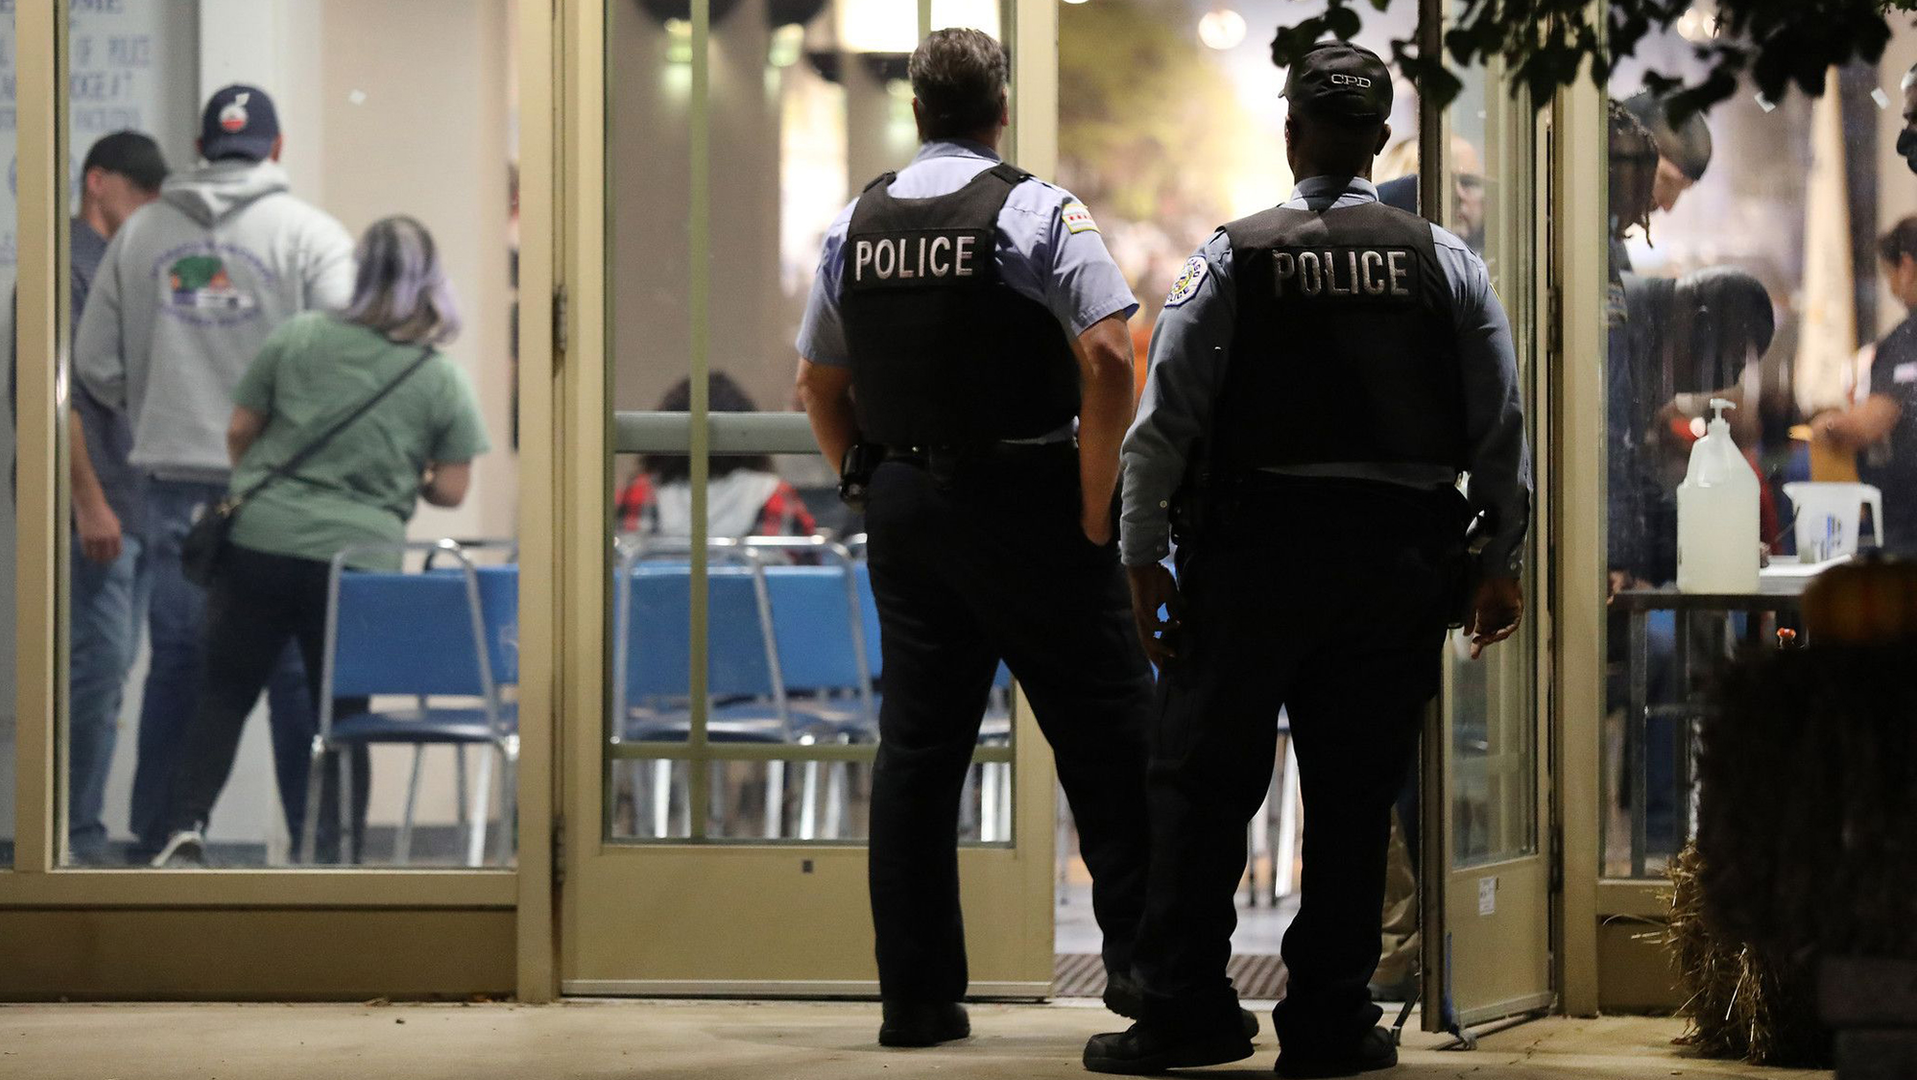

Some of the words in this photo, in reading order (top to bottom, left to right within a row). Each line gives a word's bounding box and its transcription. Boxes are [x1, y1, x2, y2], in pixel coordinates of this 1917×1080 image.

[1331, 73, 1371, 88] CPD
[855, 236, 975, 281] POLICE
[1272, 250, 1410, 296] POLICE
